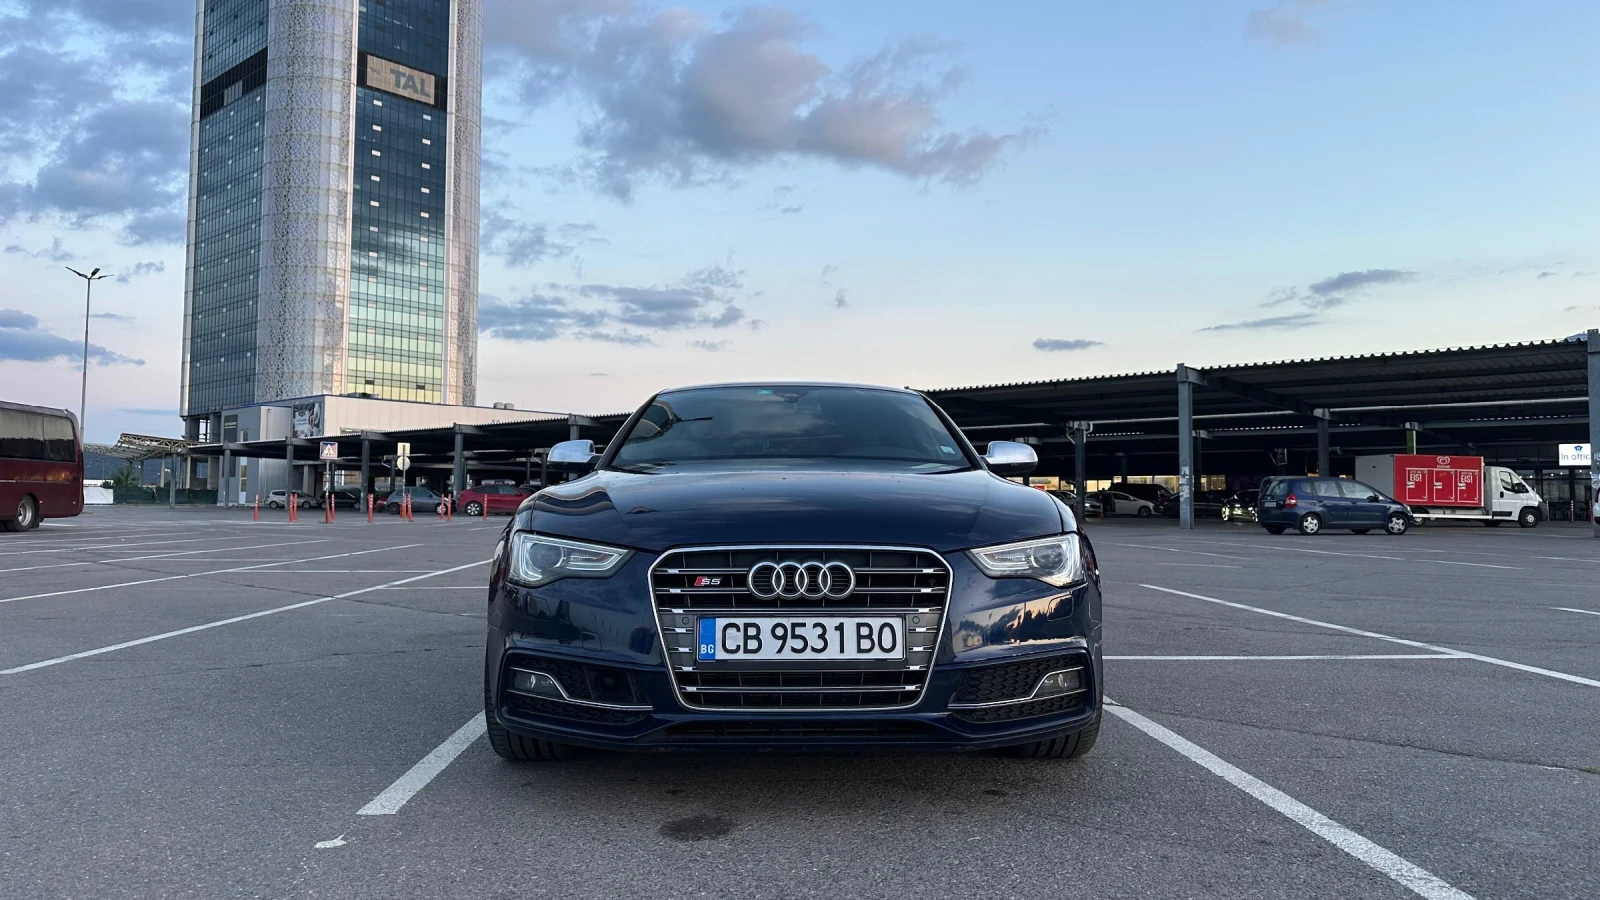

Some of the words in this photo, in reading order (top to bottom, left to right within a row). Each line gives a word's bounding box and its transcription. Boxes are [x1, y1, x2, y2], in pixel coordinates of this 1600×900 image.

[390, 68, 432, 98] TAL
[1410, 473, 1422, 482] EIS!
[1461, 475, 1473, 483] EIS!
[721, 622, 763, 654] CB
[770, 622, 845, 654] 9531
[856, 622, 897, 654] BO
[700, 644, 714, 654] BG
